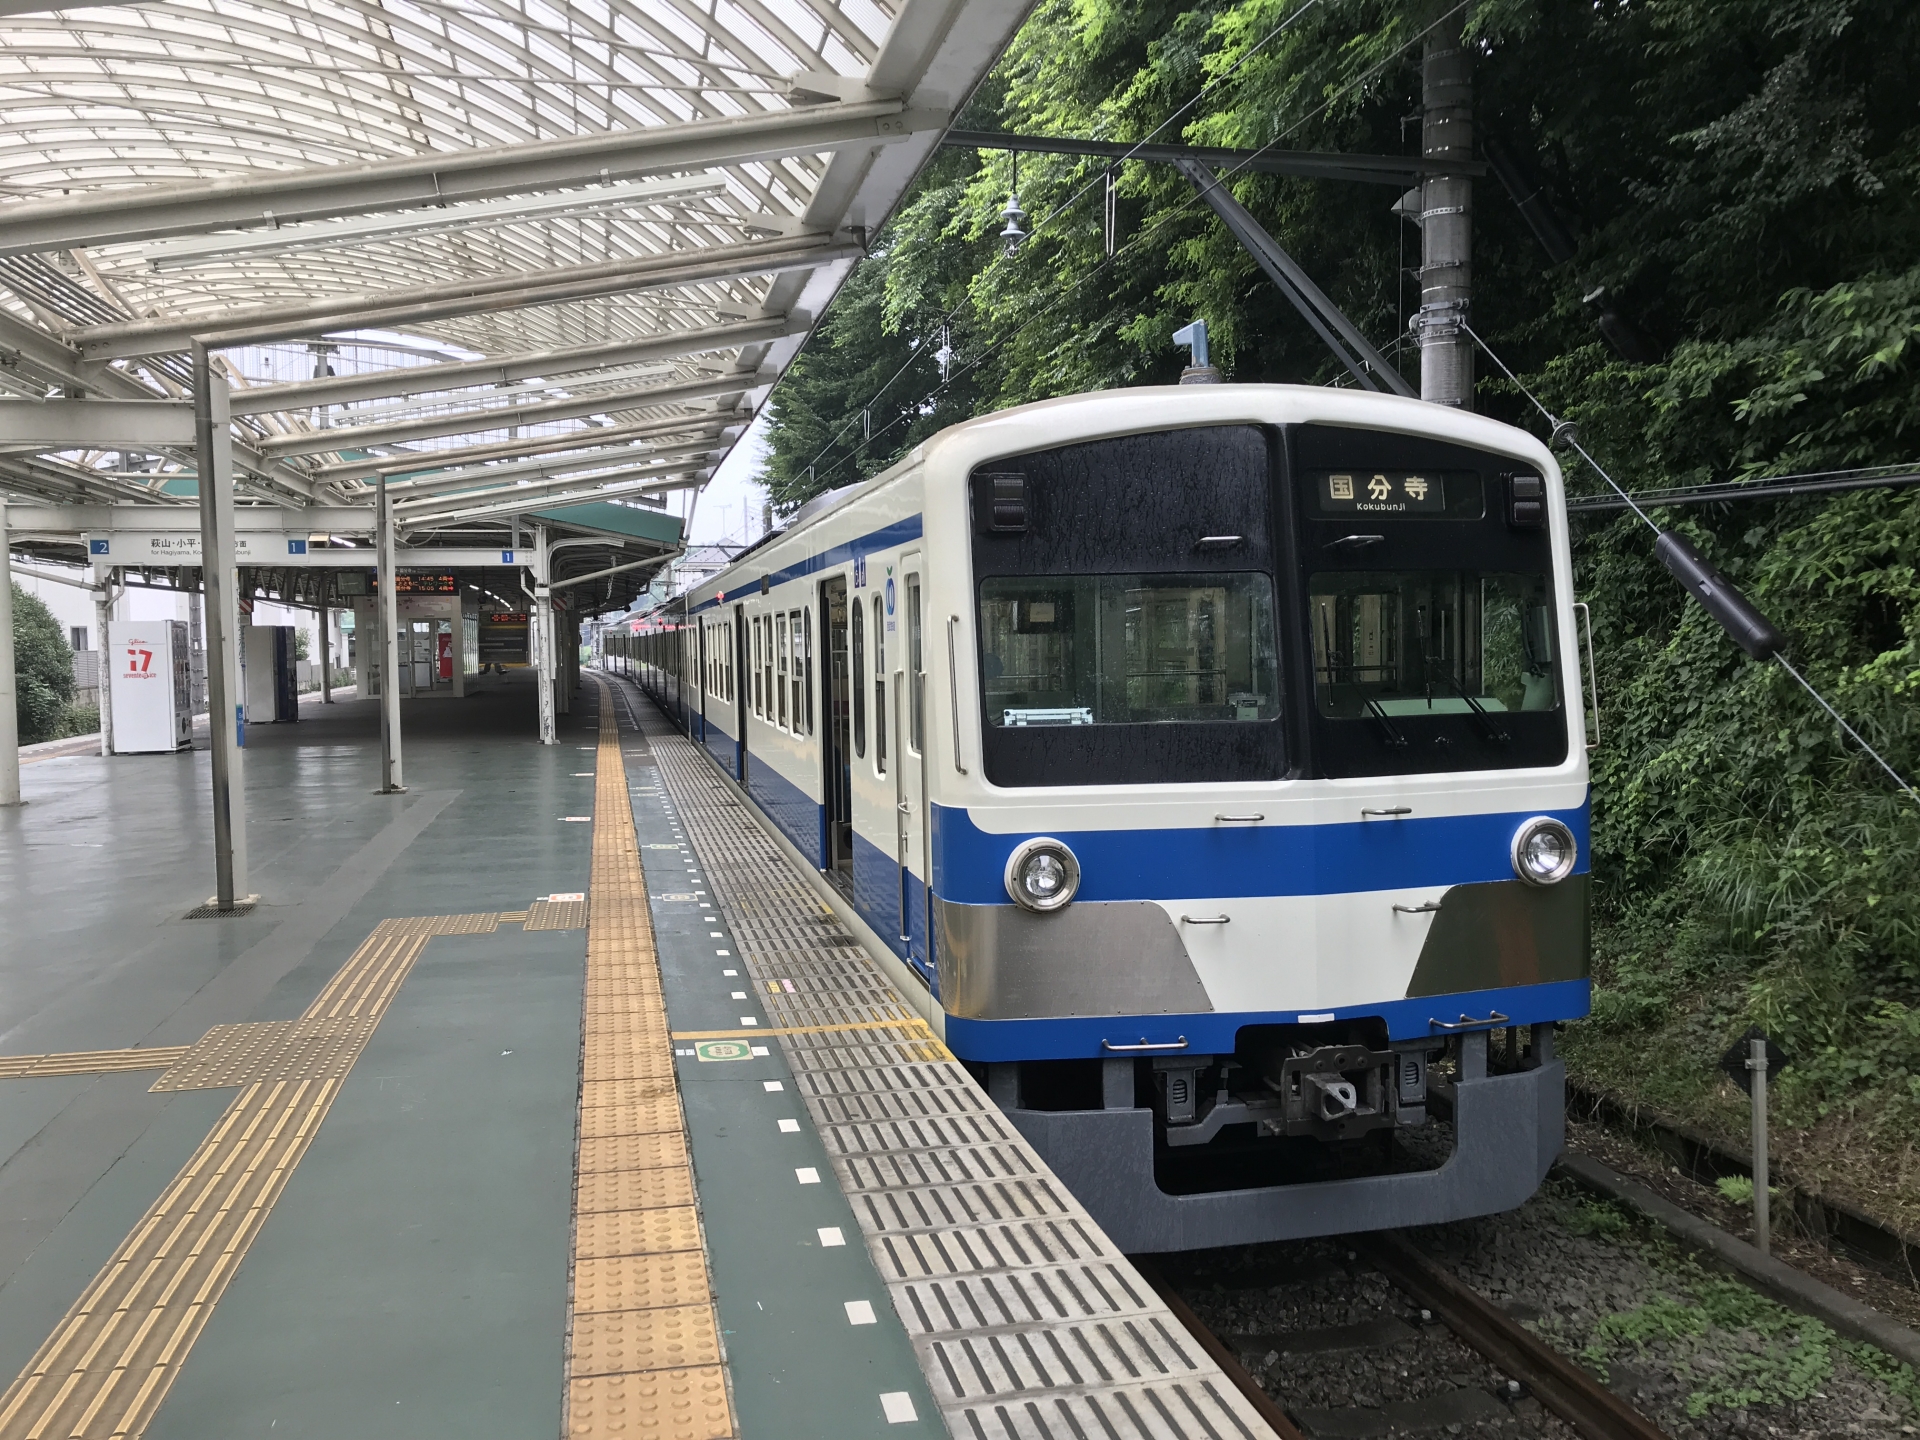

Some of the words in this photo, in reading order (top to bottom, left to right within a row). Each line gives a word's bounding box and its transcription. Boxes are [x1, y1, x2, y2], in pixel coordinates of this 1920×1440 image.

[1329, 475, 1428, 500] 国分寺
[1356, 503, 1406, 511] Kokubunji
[99, 542, 108, 553] 2
[291, 542, 296, 553] 1
[505, 553, 510, 561] 1
